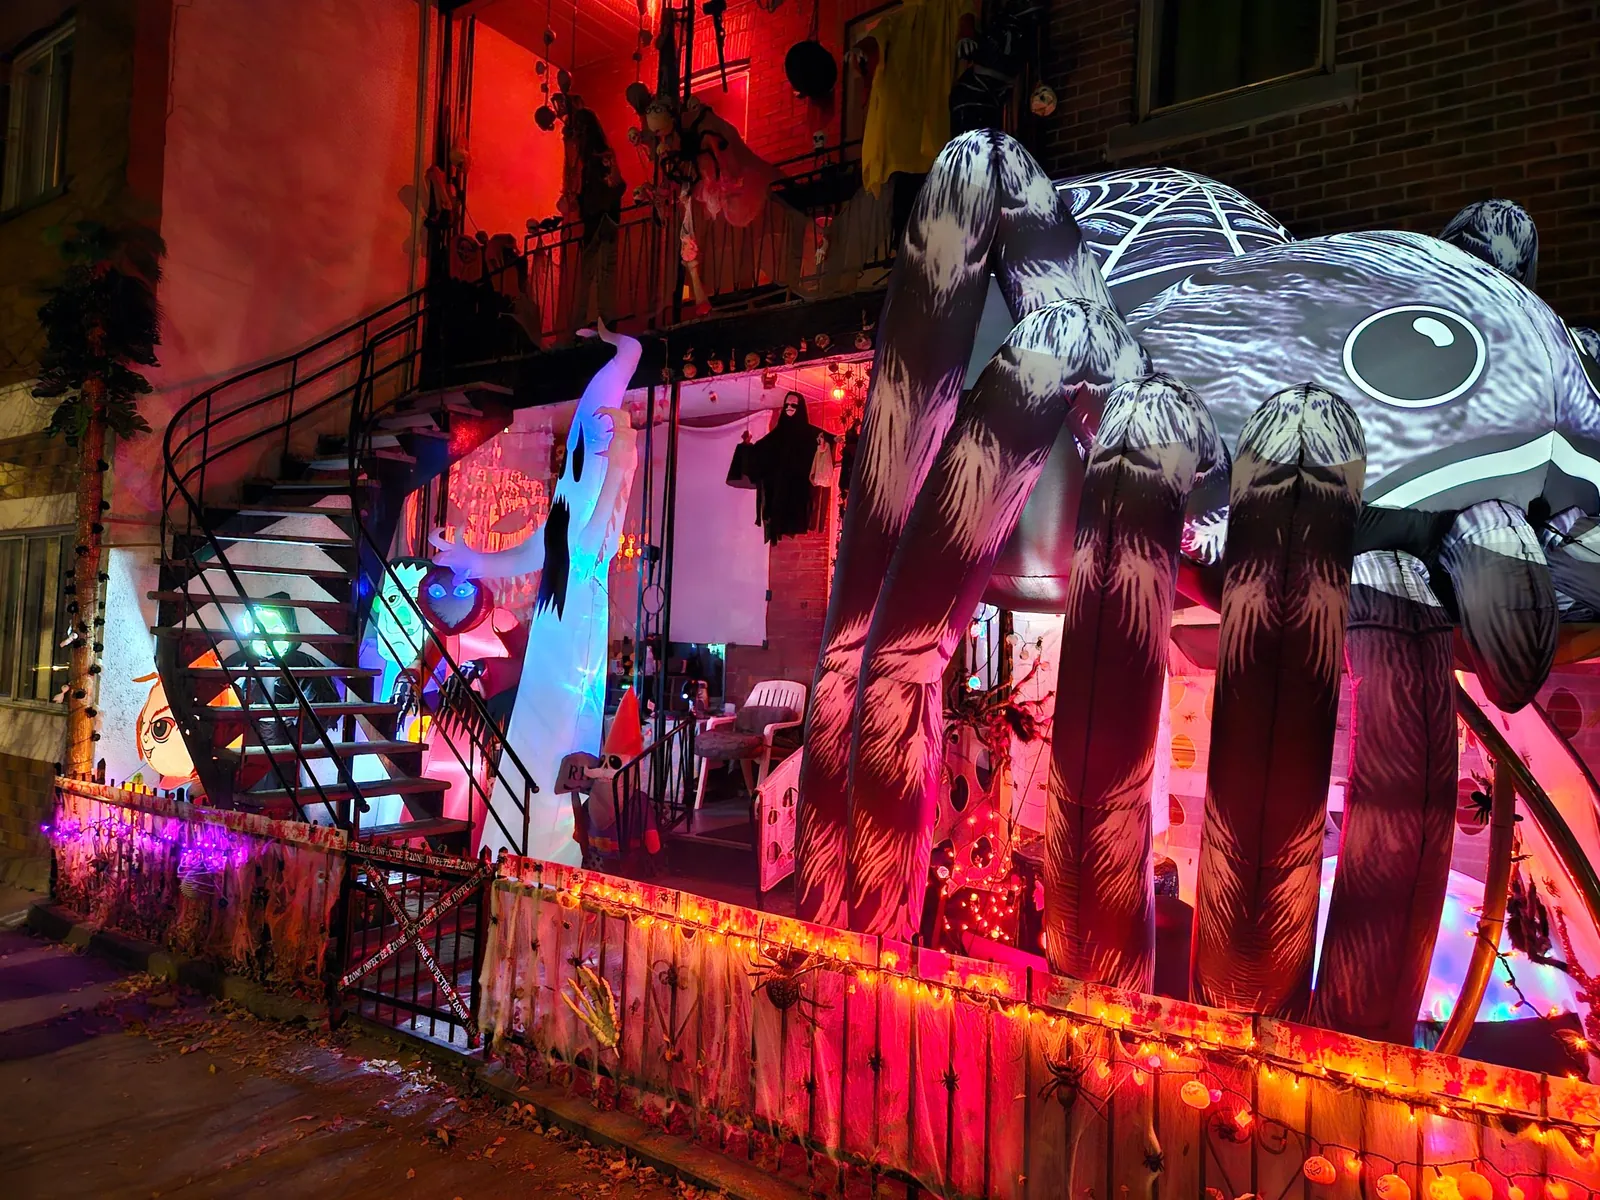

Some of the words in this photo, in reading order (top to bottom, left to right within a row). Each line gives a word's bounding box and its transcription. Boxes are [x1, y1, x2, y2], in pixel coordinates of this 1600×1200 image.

[568, 764, 587, 781] RI
[437, 897, 453, 914] ZONE
[414, 938, 430, 960] ZONE
